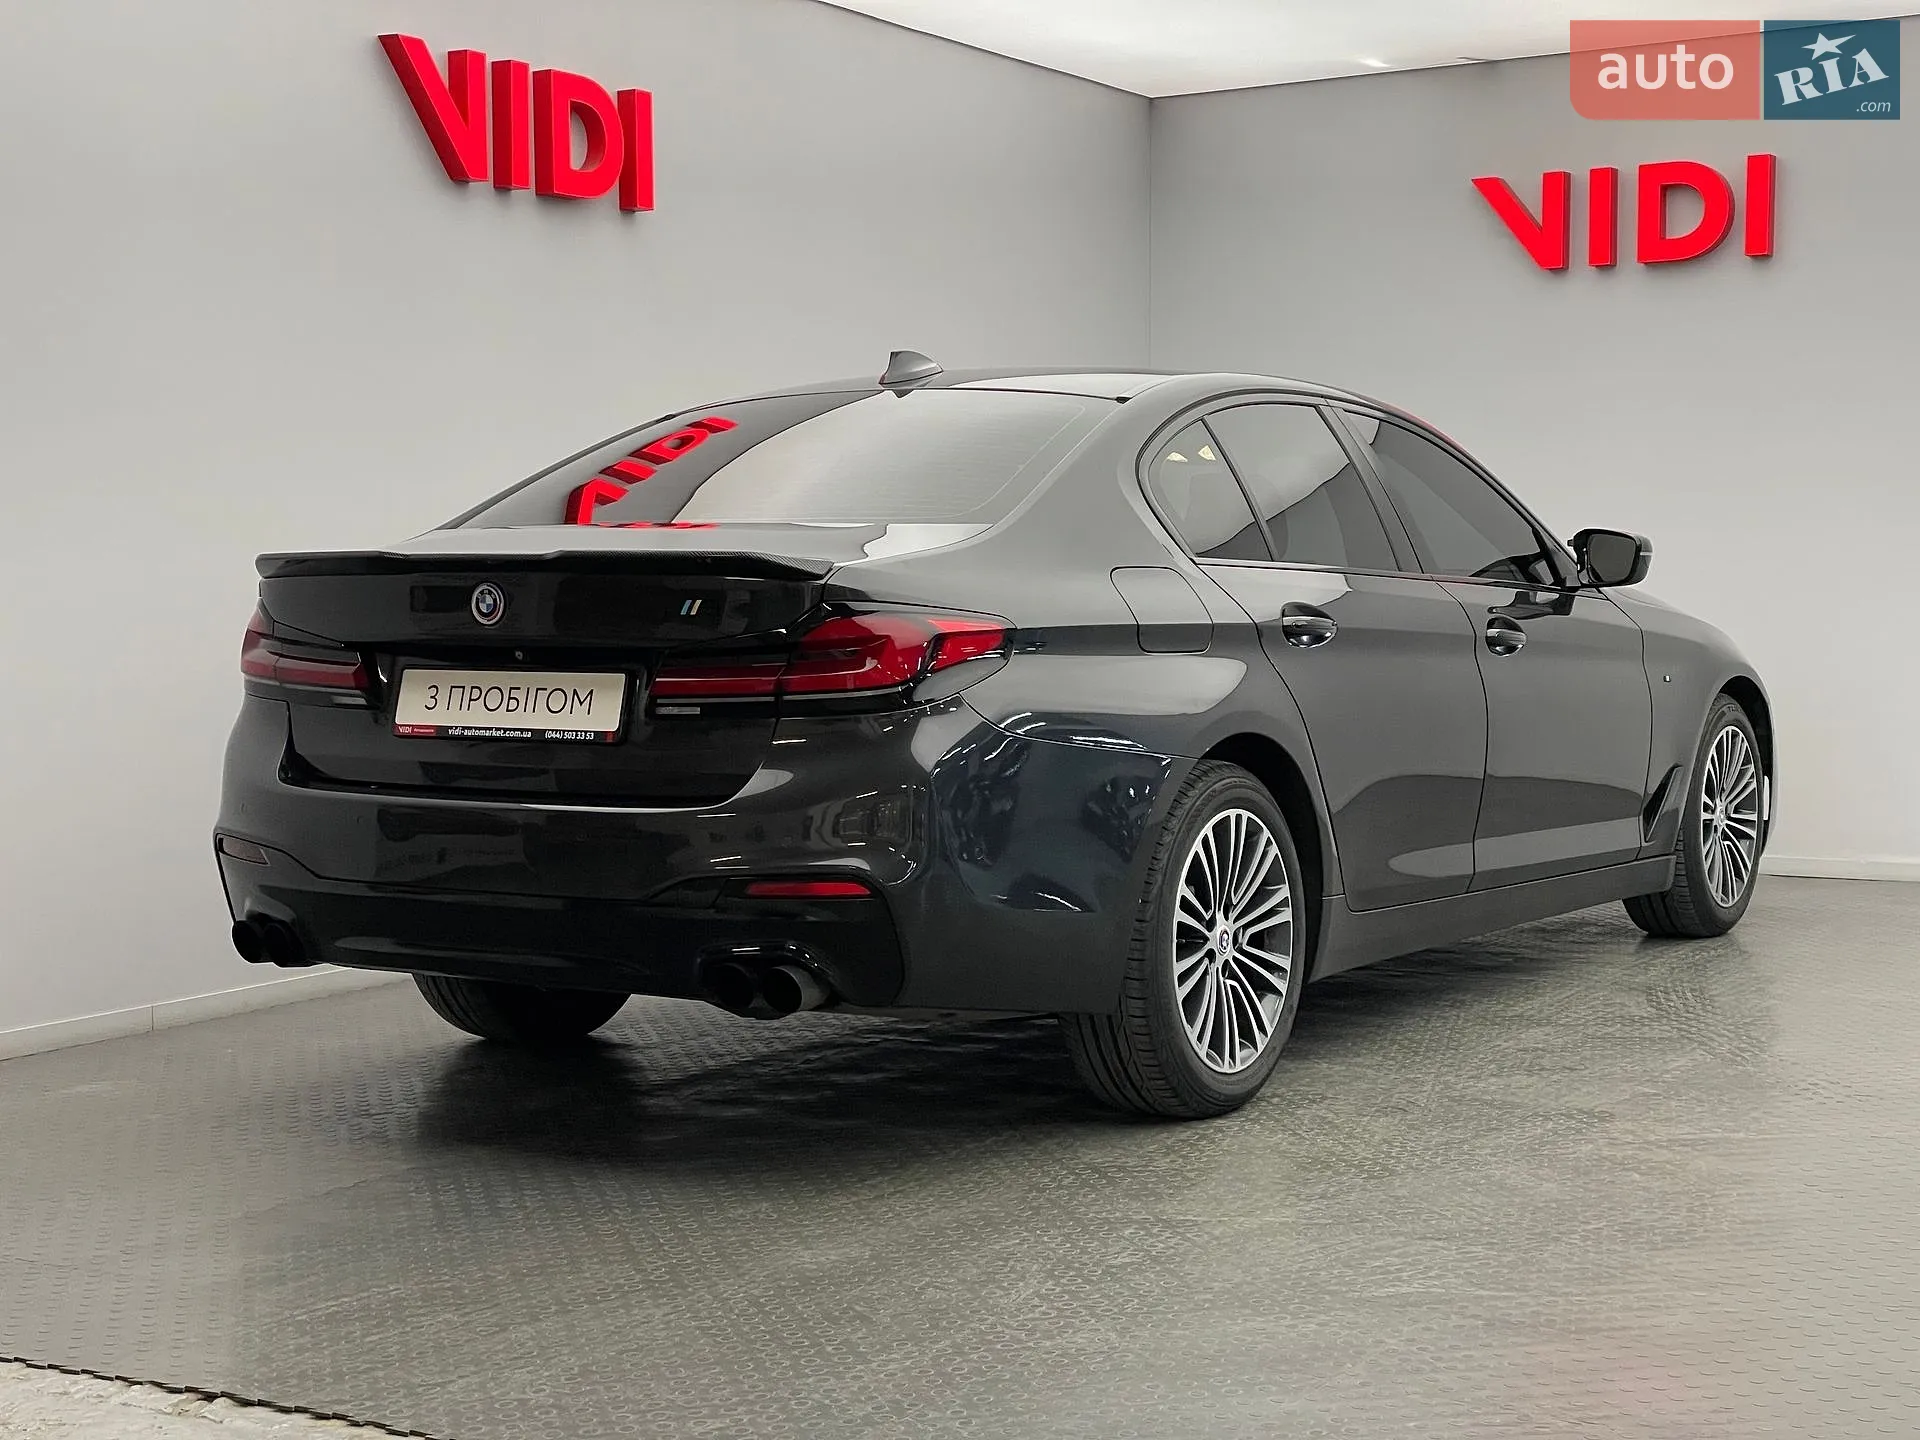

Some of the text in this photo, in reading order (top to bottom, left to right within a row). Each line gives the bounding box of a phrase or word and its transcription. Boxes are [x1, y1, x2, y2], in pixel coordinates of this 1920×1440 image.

[377, 33, 654, 212] VIDI
[1471, 153, 1777, 271] VIDI
[446, 685, 594, 716] ПРОБІГОМ
[448, 727, 532, 738] vidi-automarket.com.ua
[544, 730, 594, 740] (044) 503 33 53
